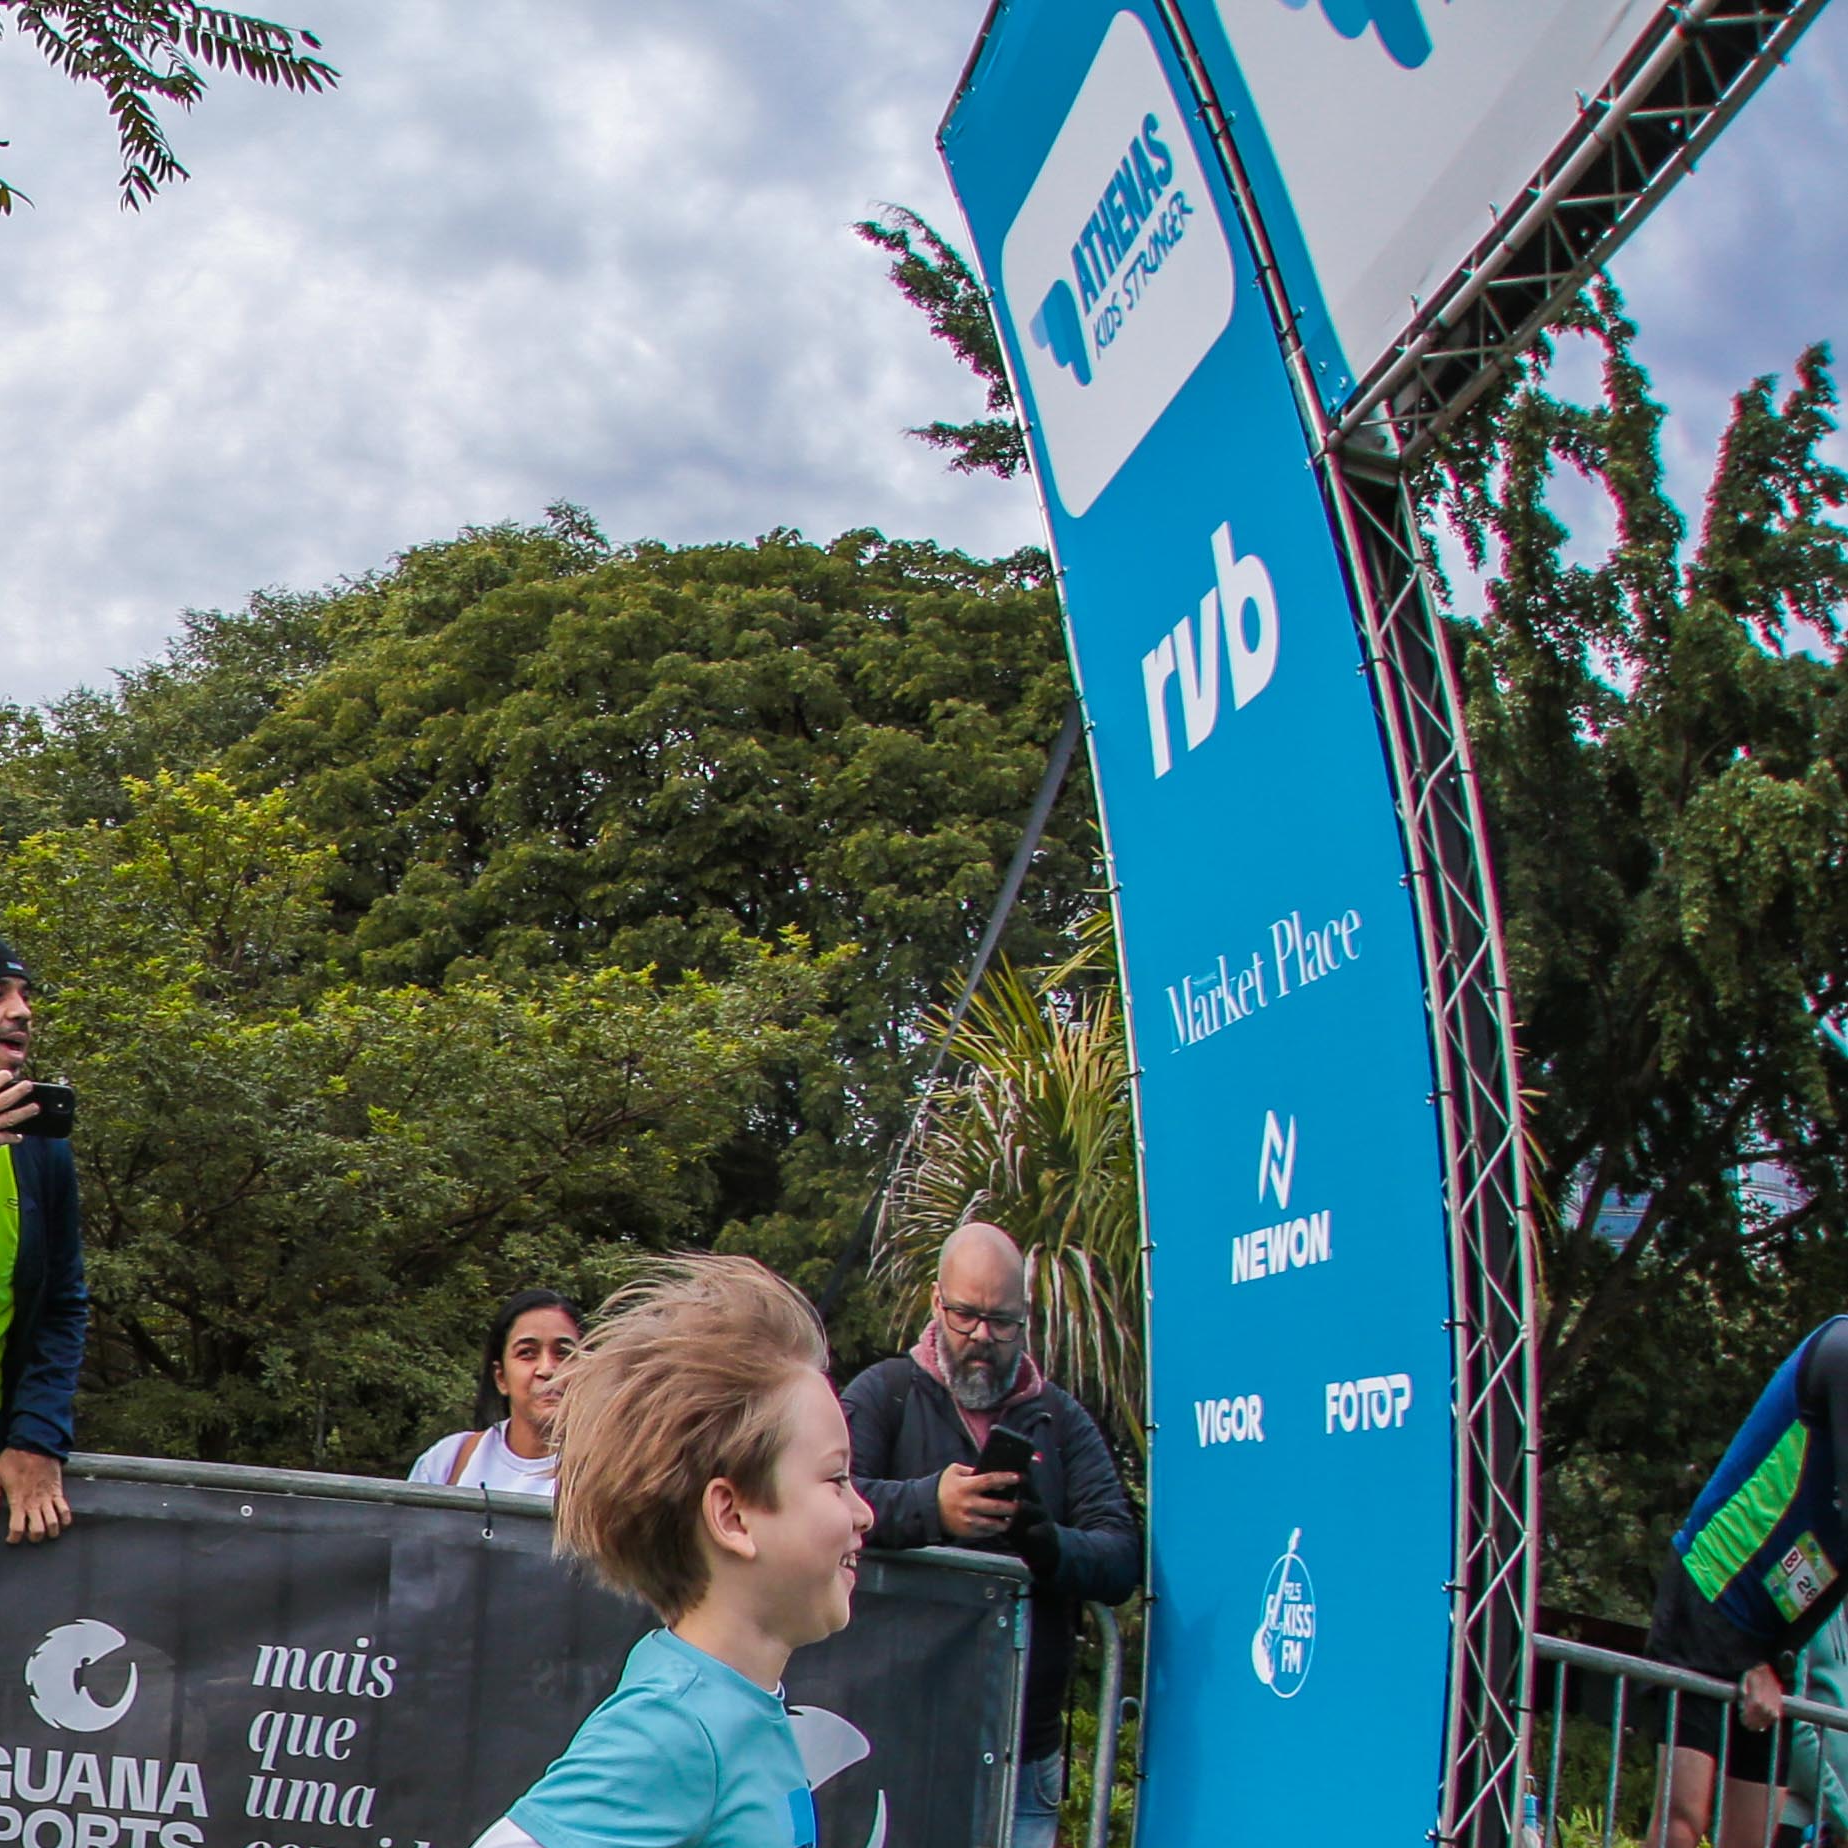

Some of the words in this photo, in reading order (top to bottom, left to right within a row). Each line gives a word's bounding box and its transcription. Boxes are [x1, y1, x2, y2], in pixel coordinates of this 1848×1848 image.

[1070, 112, 1174, 318] ATHENAS
[1093, 291, 1123, 361] KIDS
[1122, 190, 1194, 311] STRONGER
[1140, 520, 1280, 780] rvb
[1165, 951, 1268, 1055] Market
[1267, 909, 1363, 999] Place
[1231, 1209, 1332, 1285] NEWON
[1194, 1393, 1266, 1448] VIGOR
[1325, 1372, 1412, 1435] FOTOP
[1281, 1639, 1303, 1674] FM
[1282, 1603, 1313, 1638] KISS
[251, 1637, 398, 1699] mais
[248, 1710, 358, 1771] que
[244, 1774, 377, 1829] uma
